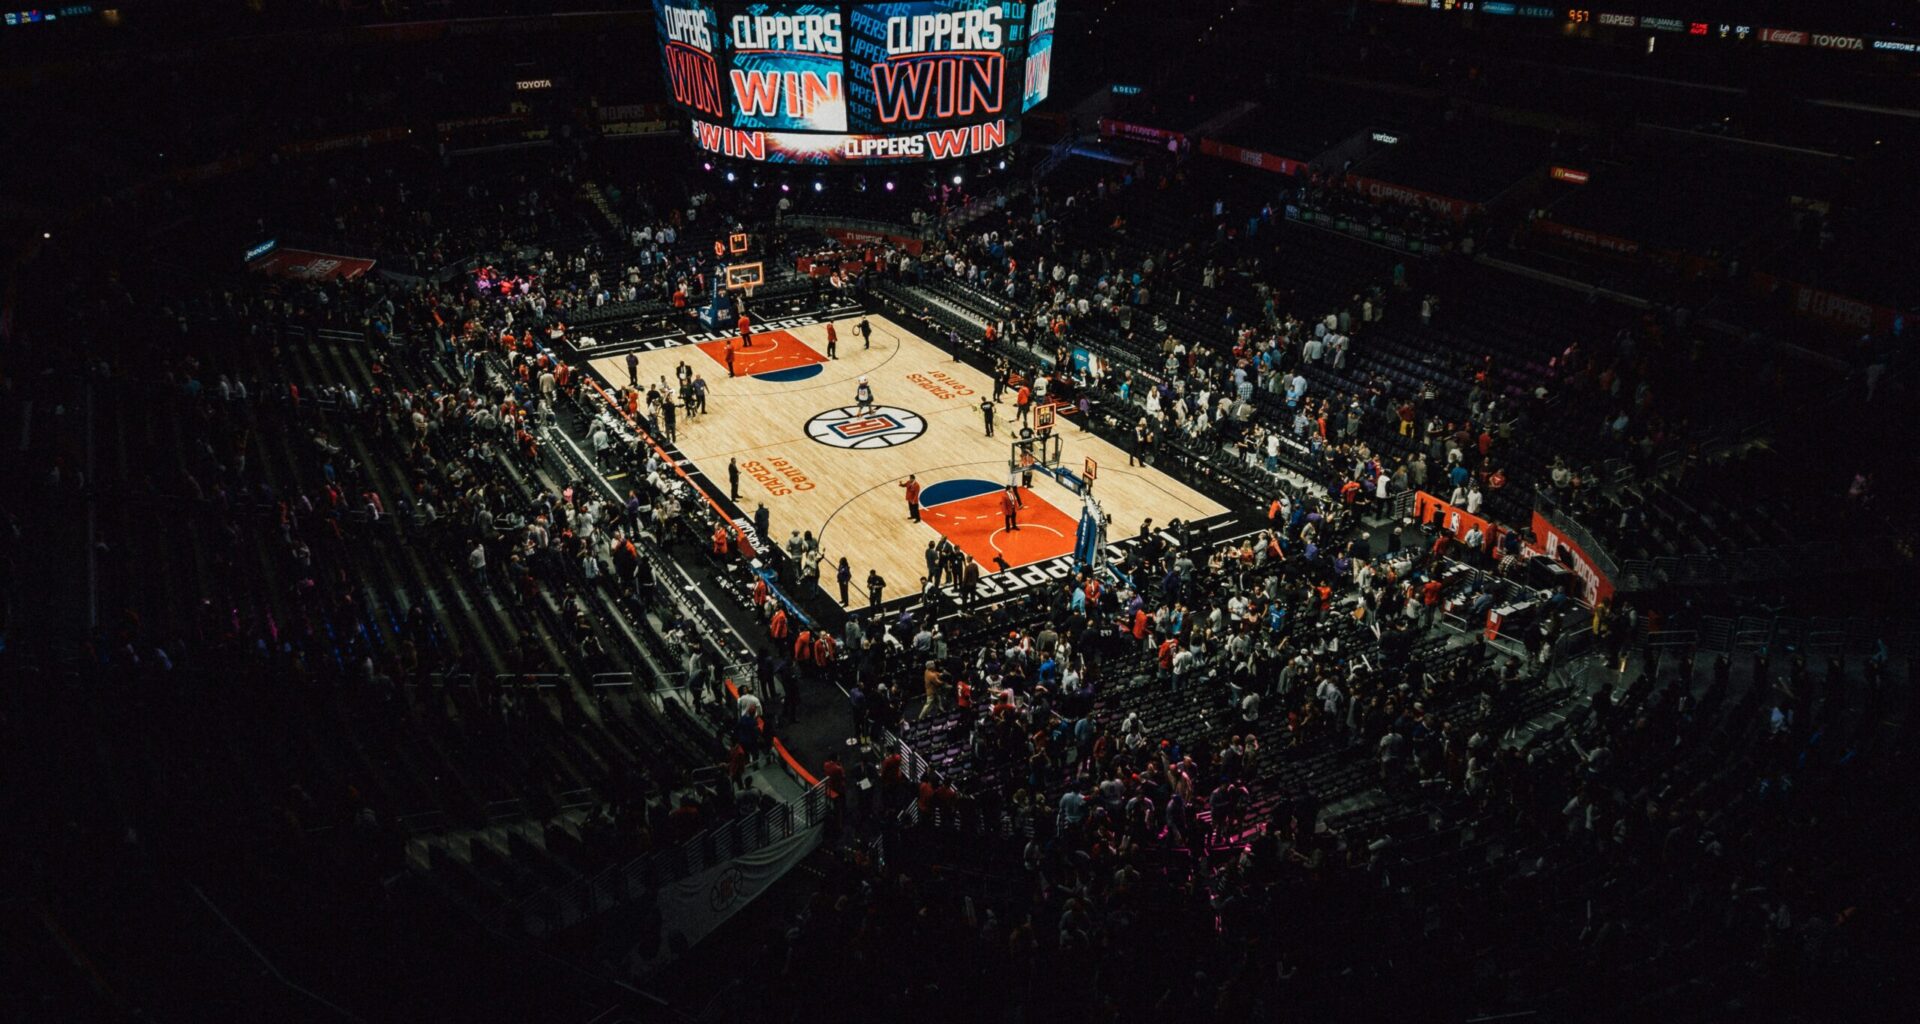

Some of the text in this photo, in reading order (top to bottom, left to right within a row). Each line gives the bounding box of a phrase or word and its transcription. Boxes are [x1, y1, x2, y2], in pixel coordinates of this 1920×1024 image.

[664, 5, 712, 53] CLIPPERS
[732, 13, 843, 54] CLIPPERS
[887, 6, 1003, 54] CLIPPERS
[1599, 13, 1636, 27] STAPLES
[1812, 34, 1864, 50] TOYOTA
[516, 80, 552, 90] TOYOTA
[665, 45, 723, 118] WIN
[870, 56, 1005, 123] WIN
[1025, 45, 1052, 100] WIN
[730, 69, 844, 118] WIN
[699, 121, 765, 161] WIN
[845, 119, 1005, 160] CLIPPERS WIN
[1372, 132, 1398, 144] verizon
[644, 336, 684, 350] LA
[906, 373, 956, 400] STAPLES
[927, 369, 975, 396] Center
[741, 460, 793, 497] STAPLES
[766, 456, 816, 493] Center
